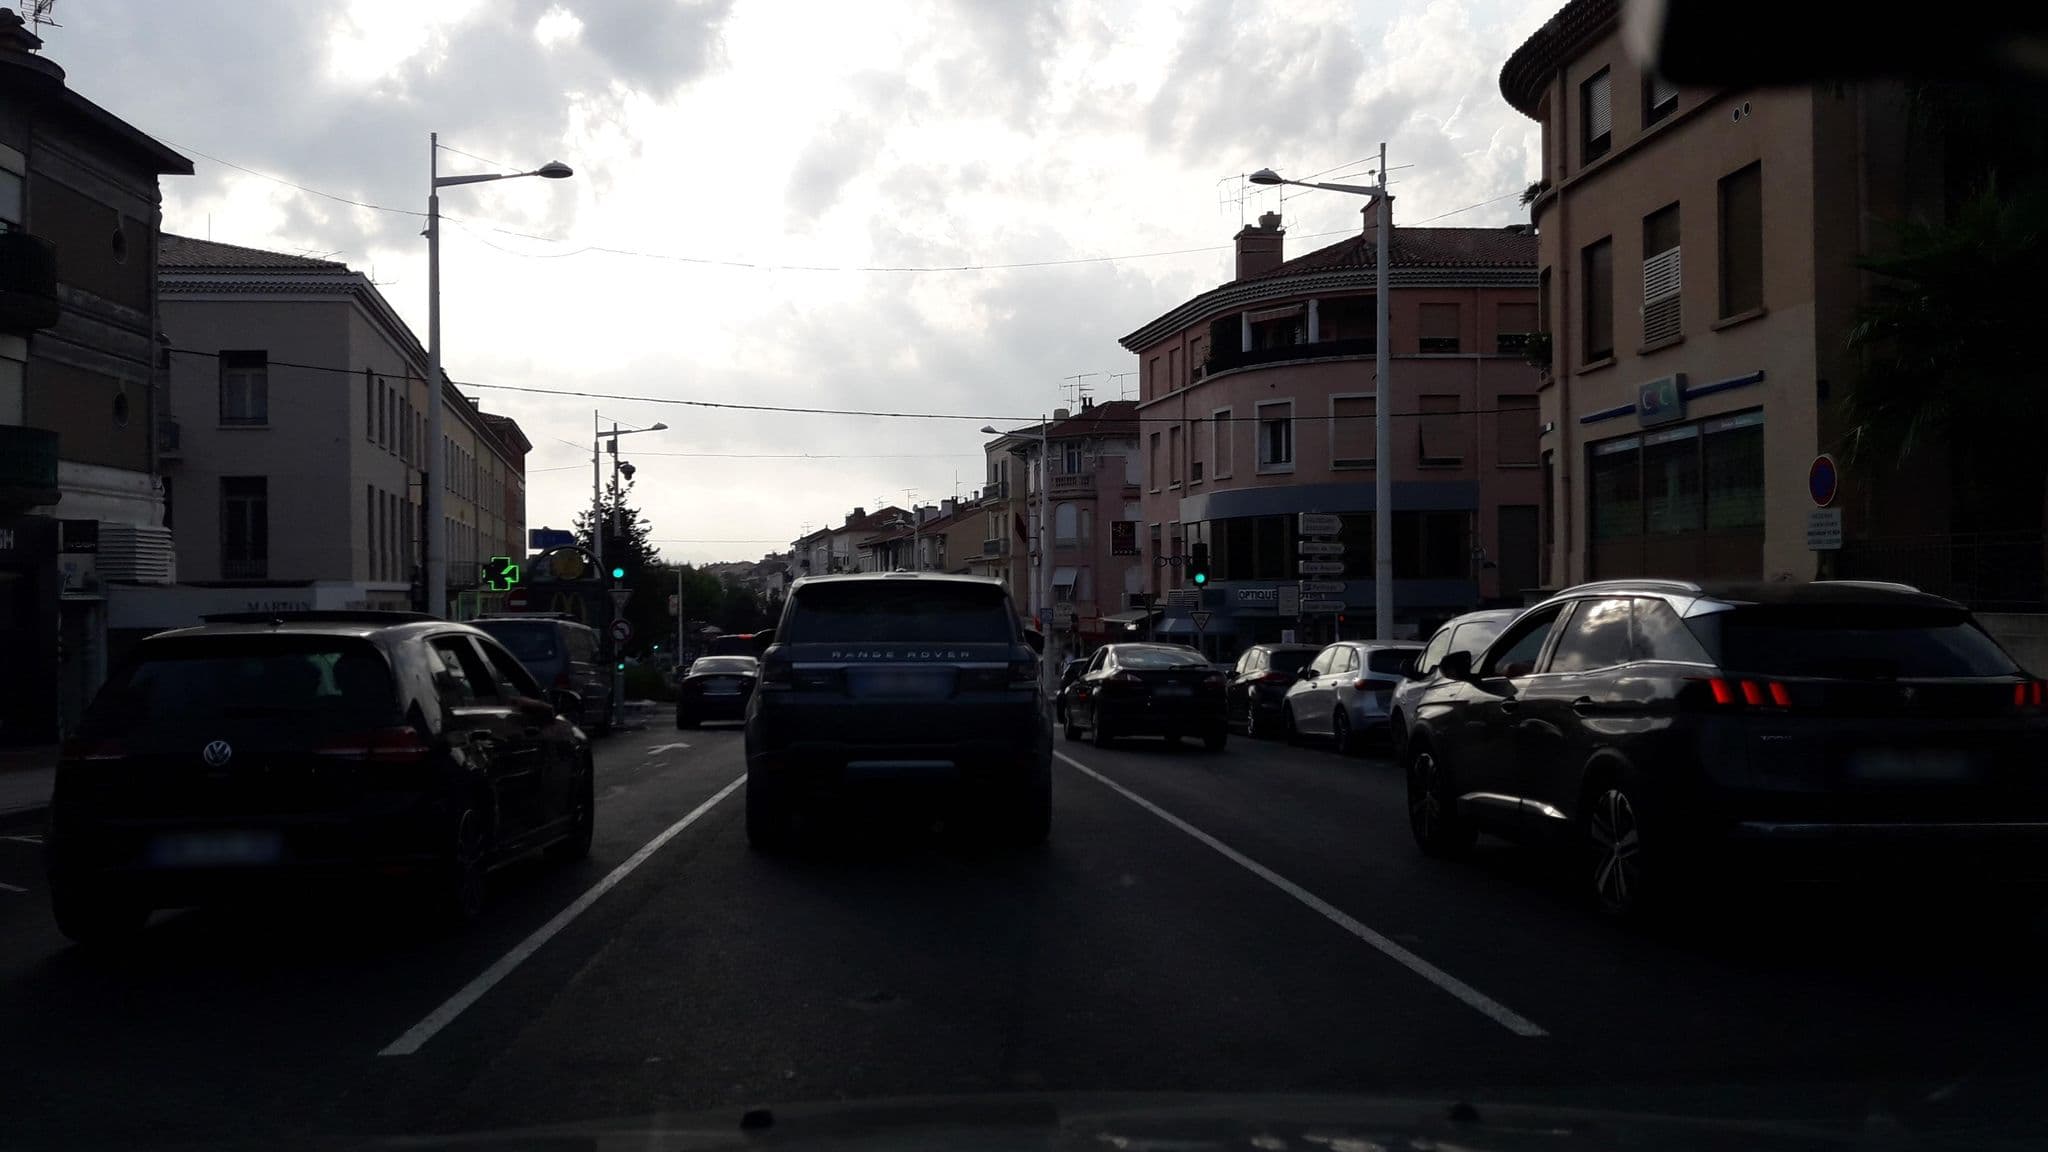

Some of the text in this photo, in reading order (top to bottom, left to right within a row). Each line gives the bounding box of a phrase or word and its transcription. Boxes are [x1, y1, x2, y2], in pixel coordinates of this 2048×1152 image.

[1238, 589, 1278, 600] OPTIQUE
[831, 650, 969, 658] RANGE ROVER
